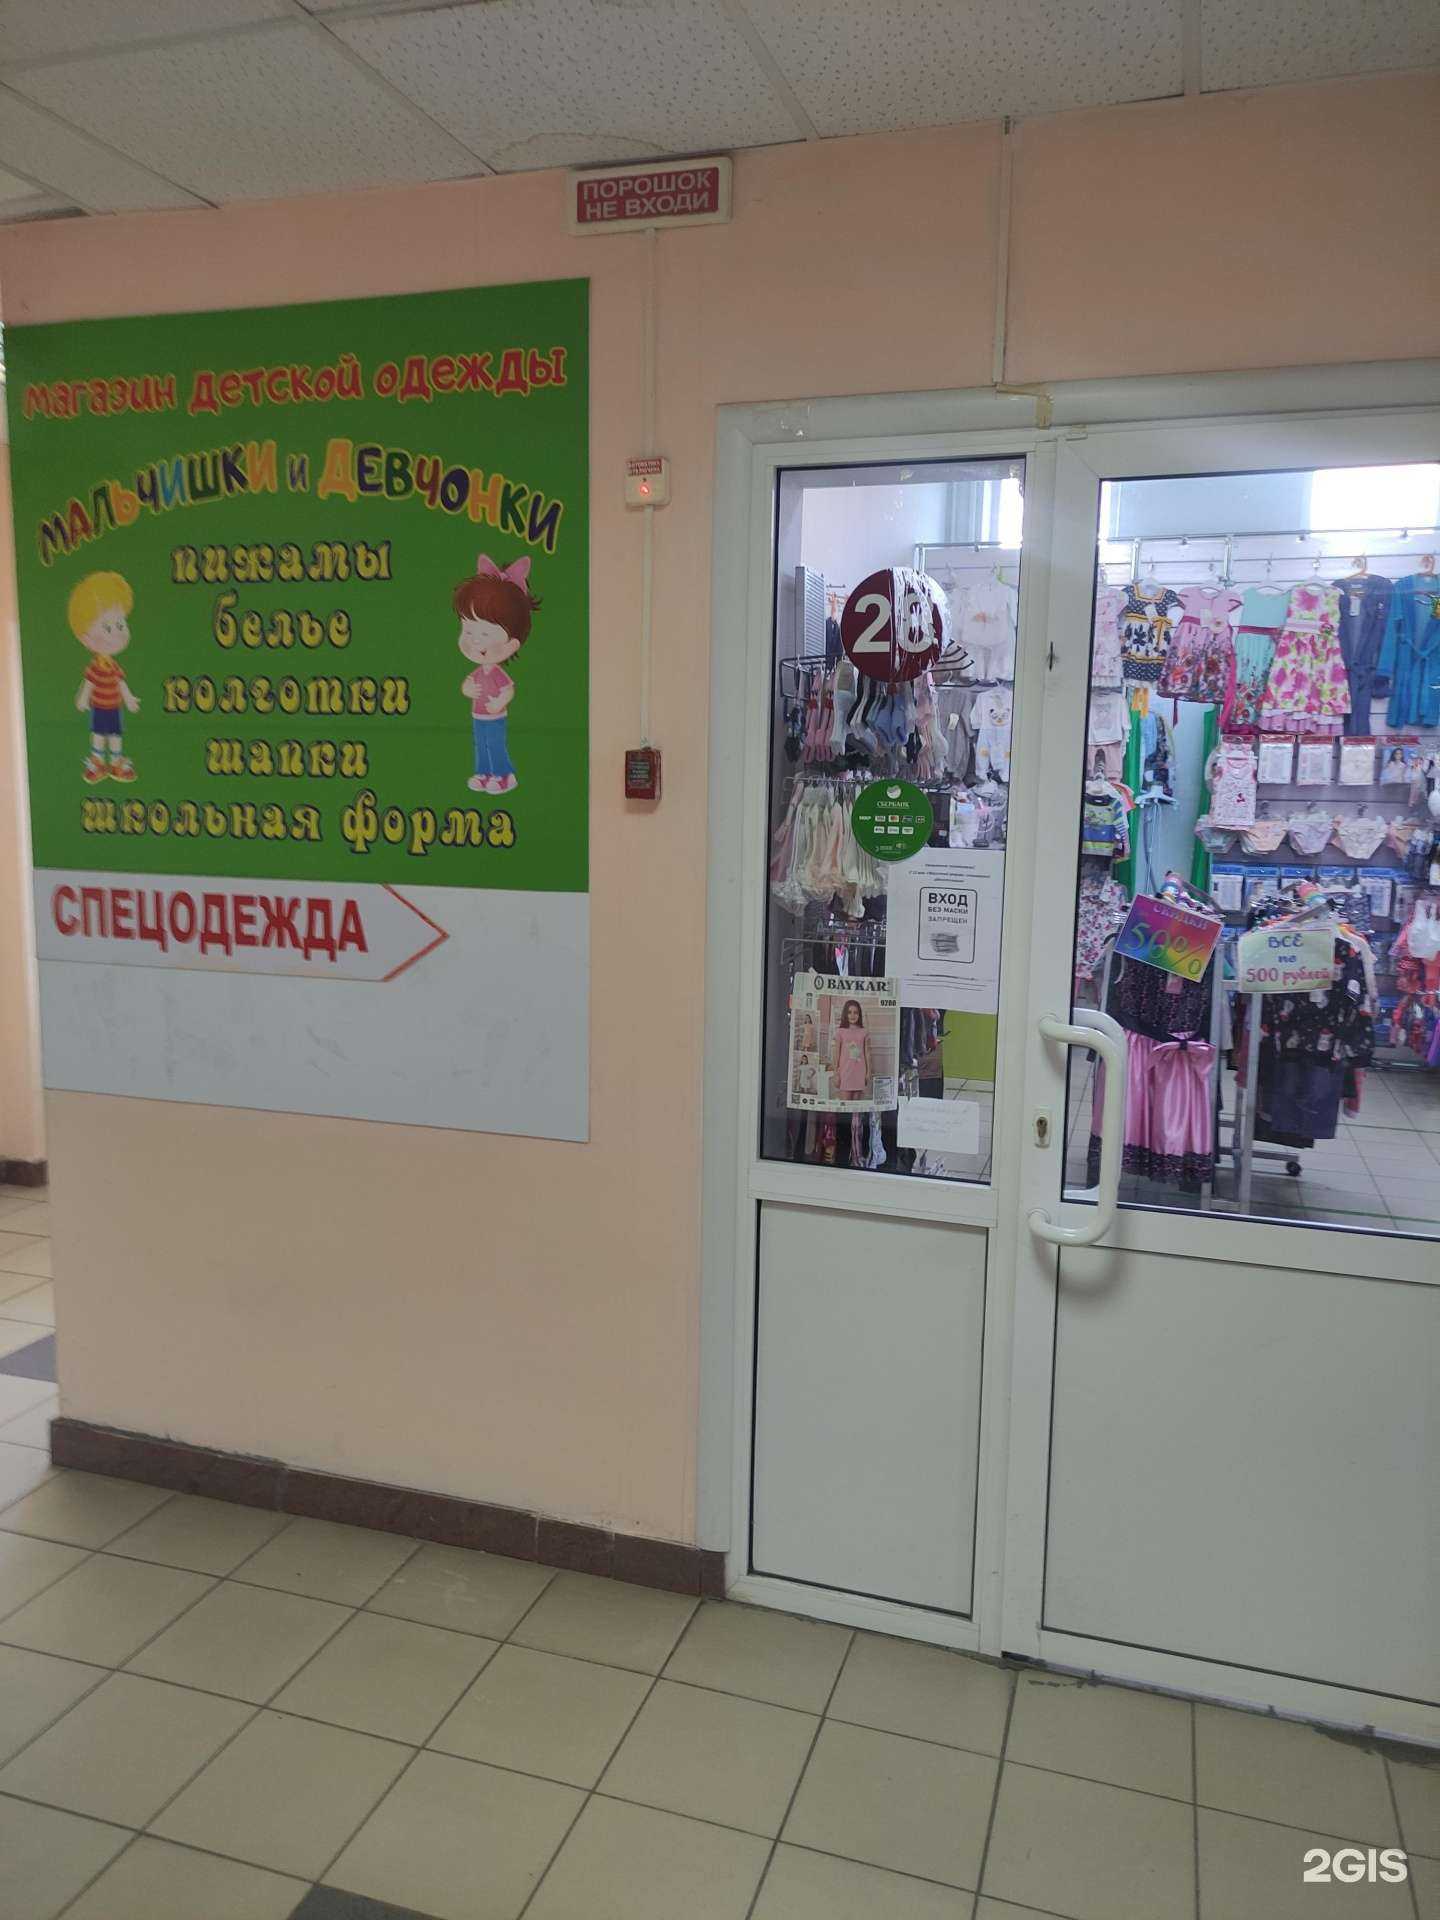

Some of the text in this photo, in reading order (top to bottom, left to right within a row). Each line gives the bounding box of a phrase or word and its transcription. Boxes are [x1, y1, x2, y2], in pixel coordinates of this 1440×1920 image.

[583, 170, 712, 200] ПОРОШОК
[585, 191, 710, 220] НЕ ВХОДИ
[23, 374, 177, 420] магазин
[36, 440, 279, 567] МАЛЬЧИШКИ
[318, 437, 564, 554] ДЕВЧОНКИ
[170, 540, 393, 584] пижамы
[213, 588, 352, 650] белье
[162, 675, 412, 716] колготки
[205, 737, 369, 778] шапки
[80, 788, 516, 857] школьная форма
[928, 893, 968, 908] ВХОД
[928, 915, 968, 925] ЗАПРЕЩЕН
[943, 907, 969, 915] МАСКИ
[52, 884, 369, 962] СПЕЦОДЕЖДА
[827, 978, 888, 992] BAYKAR
[1246, 966, 1330, 986] 500 рублей
